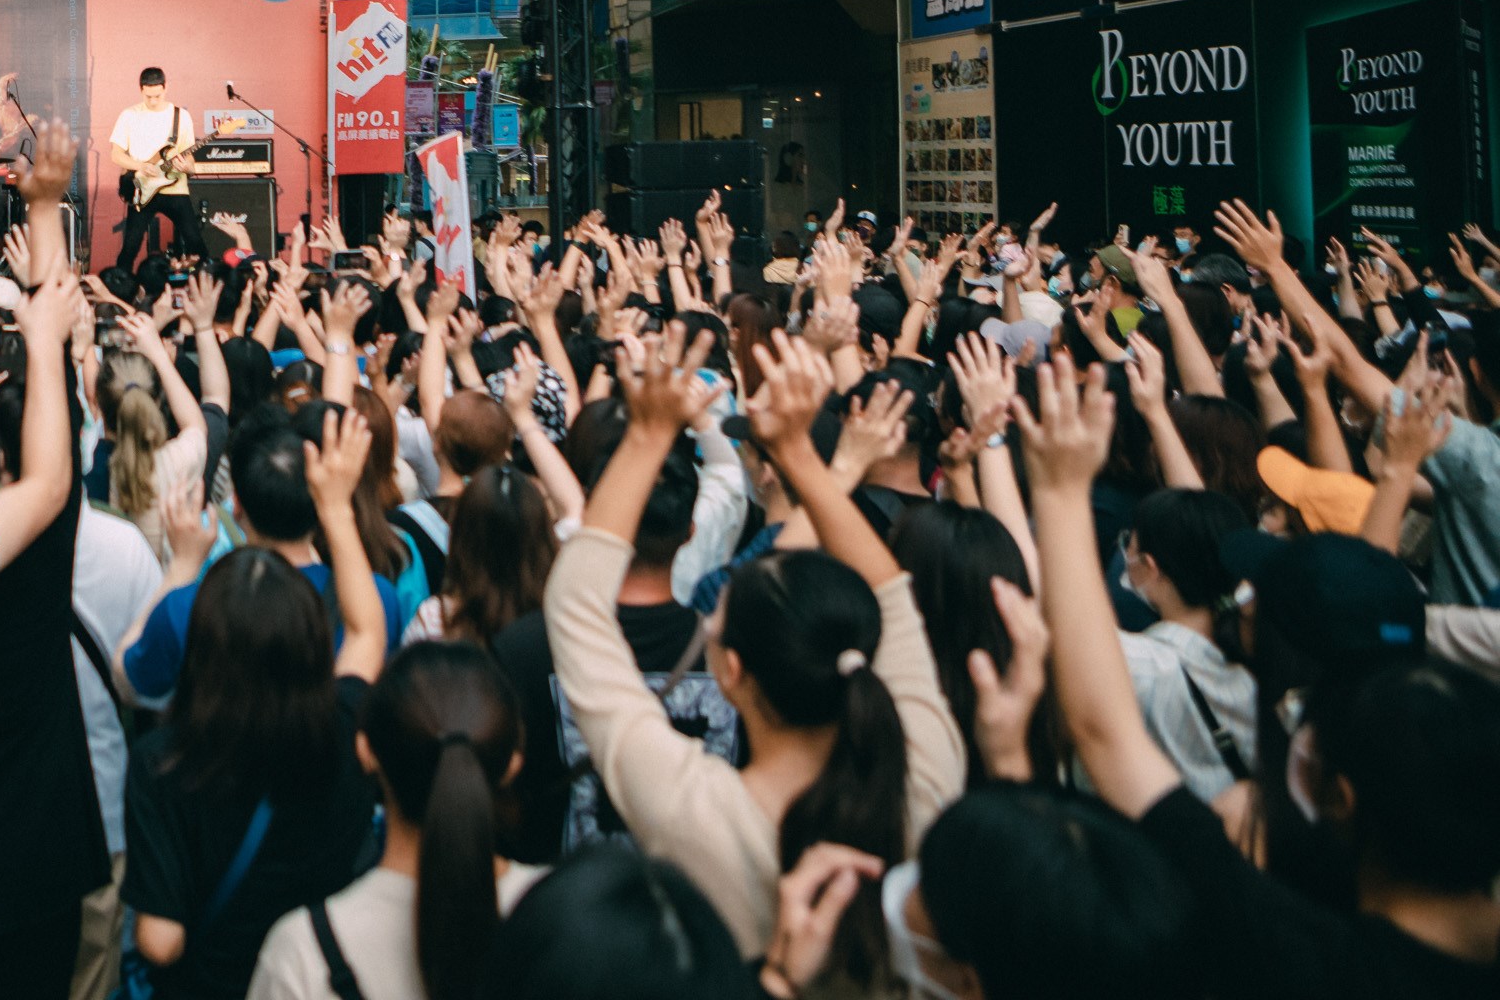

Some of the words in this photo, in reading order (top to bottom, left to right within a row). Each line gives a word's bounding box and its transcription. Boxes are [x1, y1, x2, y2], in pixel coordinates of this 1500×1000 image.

[336, 35, 389, 82] hit
[376, 22, 404, 49] FM
[1092, 29, 1248, 115] BEYOND
[1337, 47, 1424, 90] BEYOND
[337, 112, 354, 128] FM
[357, 110, 400, 127] 90.1
[1351, 86, 1417, 115] YOUTH
[1117, 120, 1236, 167] YOUTH
[1348, 145, 1396, 161] MARINE
